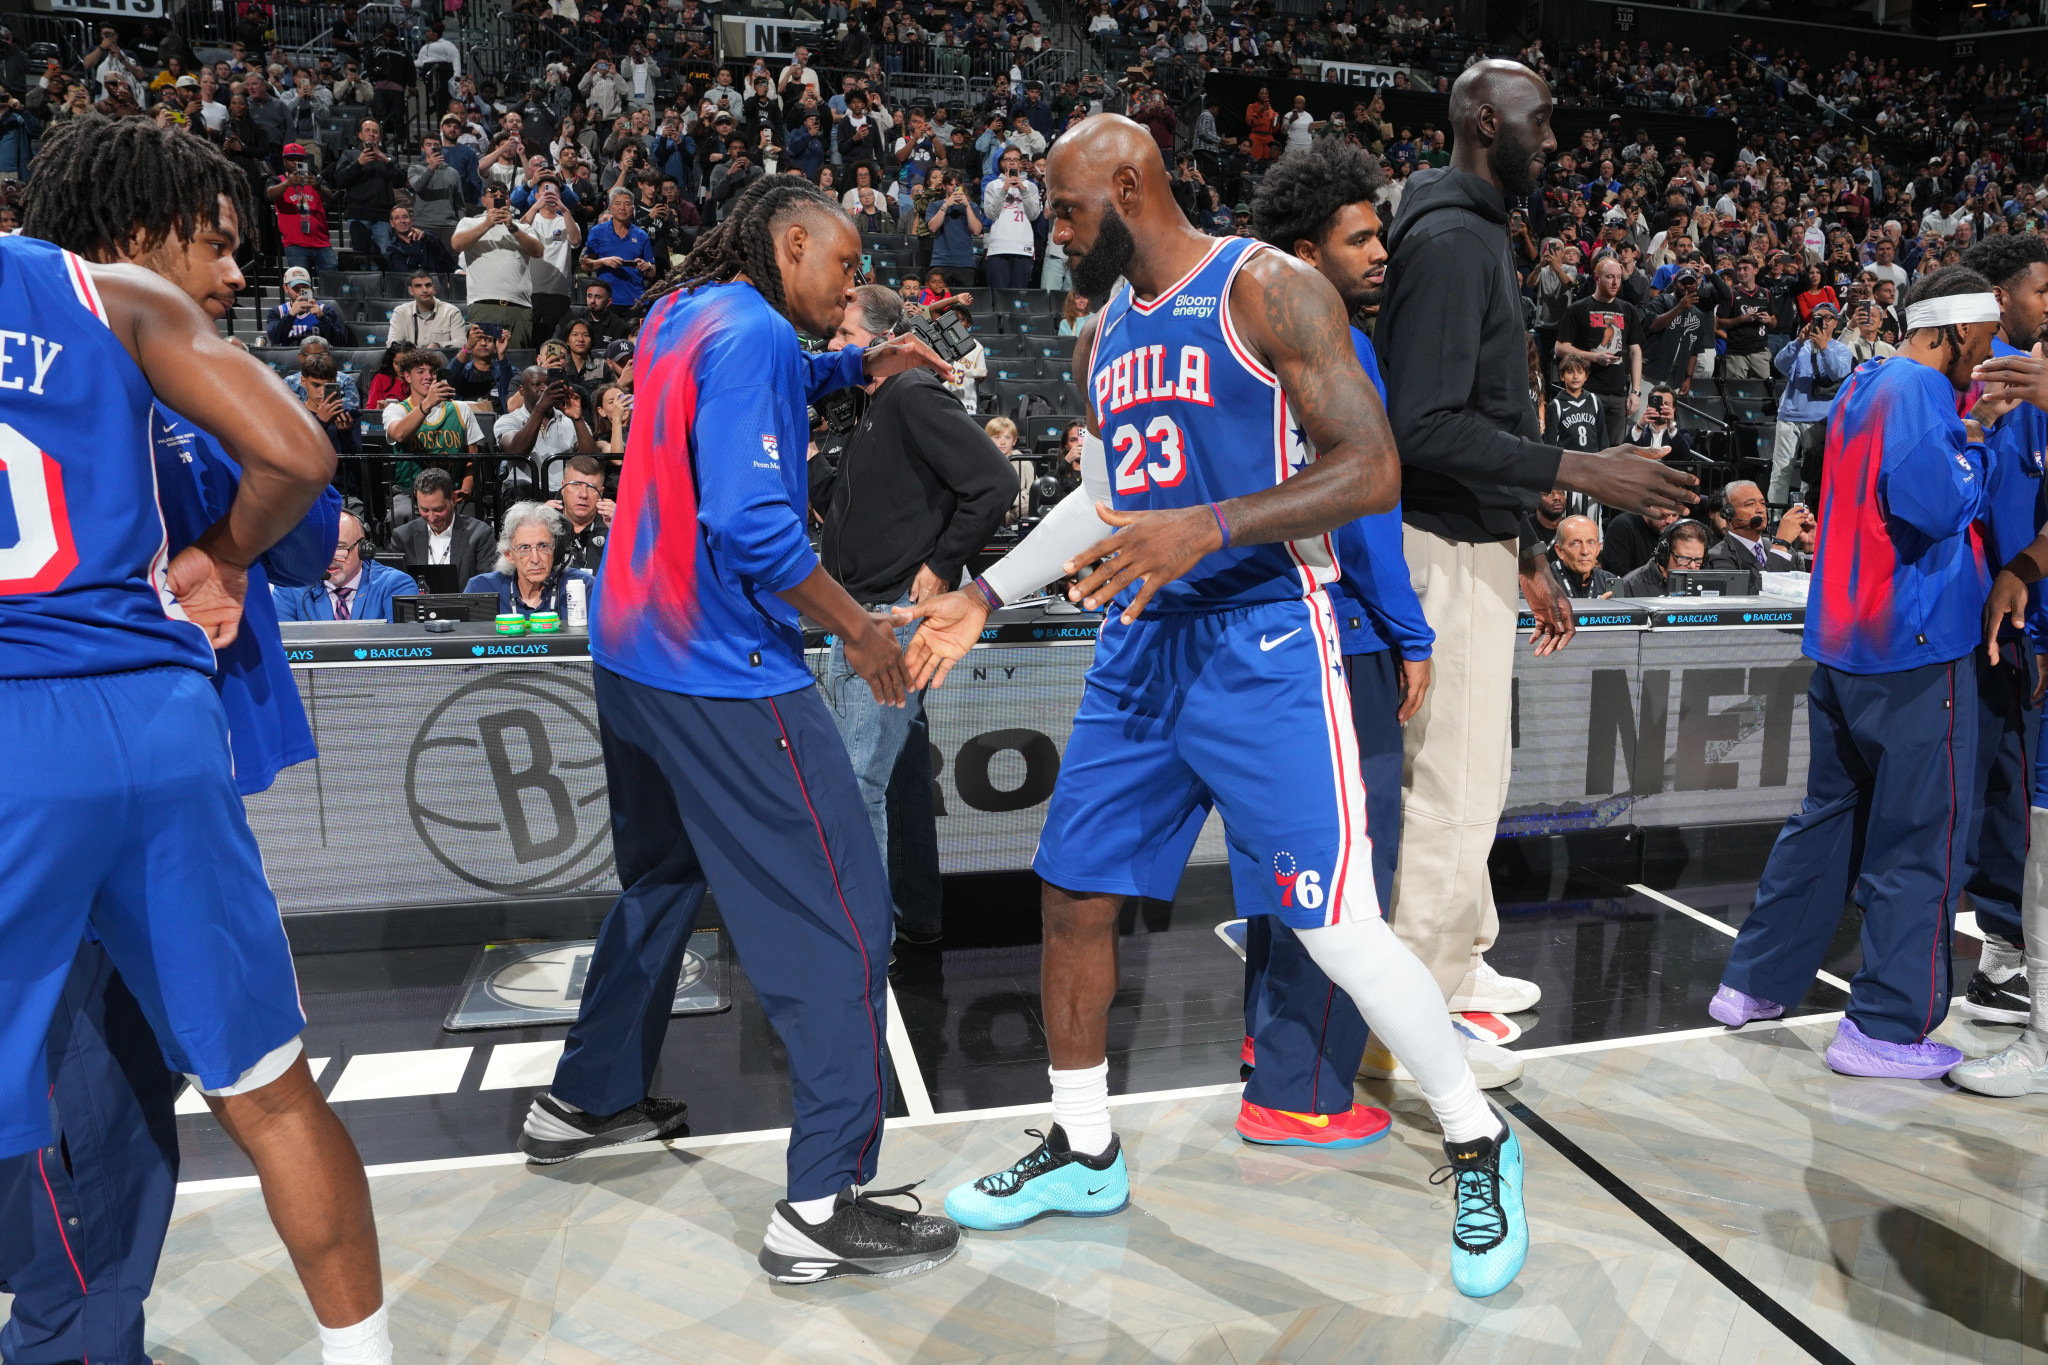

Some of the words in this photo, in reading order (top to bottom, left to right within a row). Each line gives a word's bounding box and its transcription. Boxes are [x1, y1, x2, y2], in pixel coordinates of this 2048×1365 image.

[1617, 13, 1633, 23] 110
[1014, 211, 1024, 222] 21
[1175, 293, 1217, 307] Bloom
[1172, 306, 1215, 318] energy
[619, 342, 629, 351] NY
[1095, 344, 1215, 429] PHILA
[1562, 412, 1596, 429] BROOKLYN
[410, 429, 461, 452] BOSTON
[1577, 425, 1587, 447] 8
[1115, 415, 1187, 496] 23
[753, 460, 770, 469] Penn
[1589, 616, 1631, 625] BARCLAYS
[1677, 614, 1718, 623] BARCLAYS
[1753, 613, 1793, 622] BARCLAYS
[1046, 628, 1100, 638] BARCLAYS
[370, 647, 432, 658] BARCLAYS
[487, 644, 548, 655] BARCLAYS
[285, 650, 314, 661] LAYS
[1586, 666, 1818, 796] NET
[1274, 869, 1324, 909] 76
